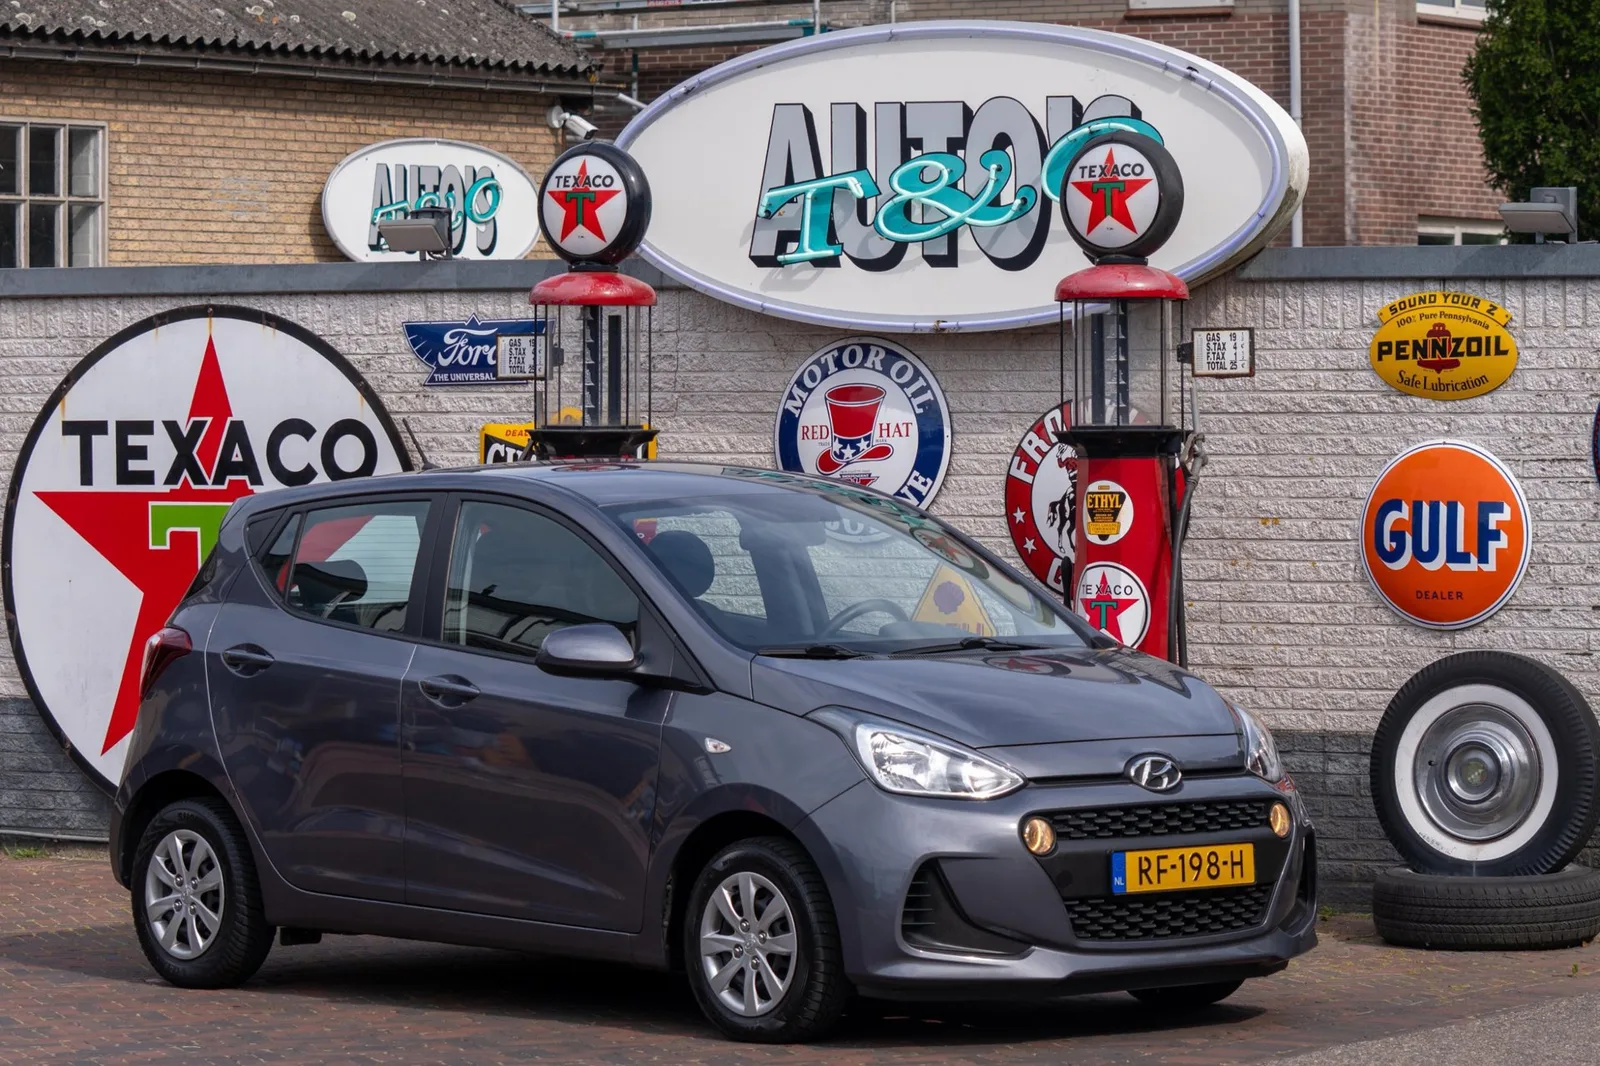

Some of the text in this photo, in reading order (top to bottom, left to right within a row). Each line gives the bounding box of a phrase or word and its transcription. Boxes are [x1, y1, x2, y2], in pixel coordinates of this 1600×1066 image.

[1079, 163, 1145, 179] TEXACO
[555, 175, 615, 188] TEXACO
[749, 94, 1142, 272] AUTO'
[1389, 293, 1498, 316] SOUND YOUR Z
[1419, 312, 1438, 321] Pure
[1439, 311, 1490, 330] Pennsylvania
[508, 338, 522, 347] GAS
[1206, 332, 1237, 342] GAS 19
[508, 347, 526, 356] S.TAX
[1206, 342, 1238, 351] S.TAX 4
[1377, 335, 1510, 361] PENNZOIL
[1206, 352, 1226, 361] F.TAX
[508, 365, 527, 374] TOTAL
[1206, 361, 1238, 371] TOTAL 25
[434, 372, 496, 381] THE UNIVERSAL
[784, 345, 935, 418] MOTOR OIL
[1397, 370, 1489, 392] Safe Lubrication
[505, 429, 529, 437] DEAL
[801, 422, 913, 441] RED HAT
[61, 417, 378, 487] TEXACO
[1087, 493, 1122, 508] ETHYL
[1374, 498, 1511, 572] GULF
[1082, 584, 1133, 596] TEXACO
[1416, 590, 1464, 600] DEALER
[1114, 849, 1244, 887] NL RF-198-H
